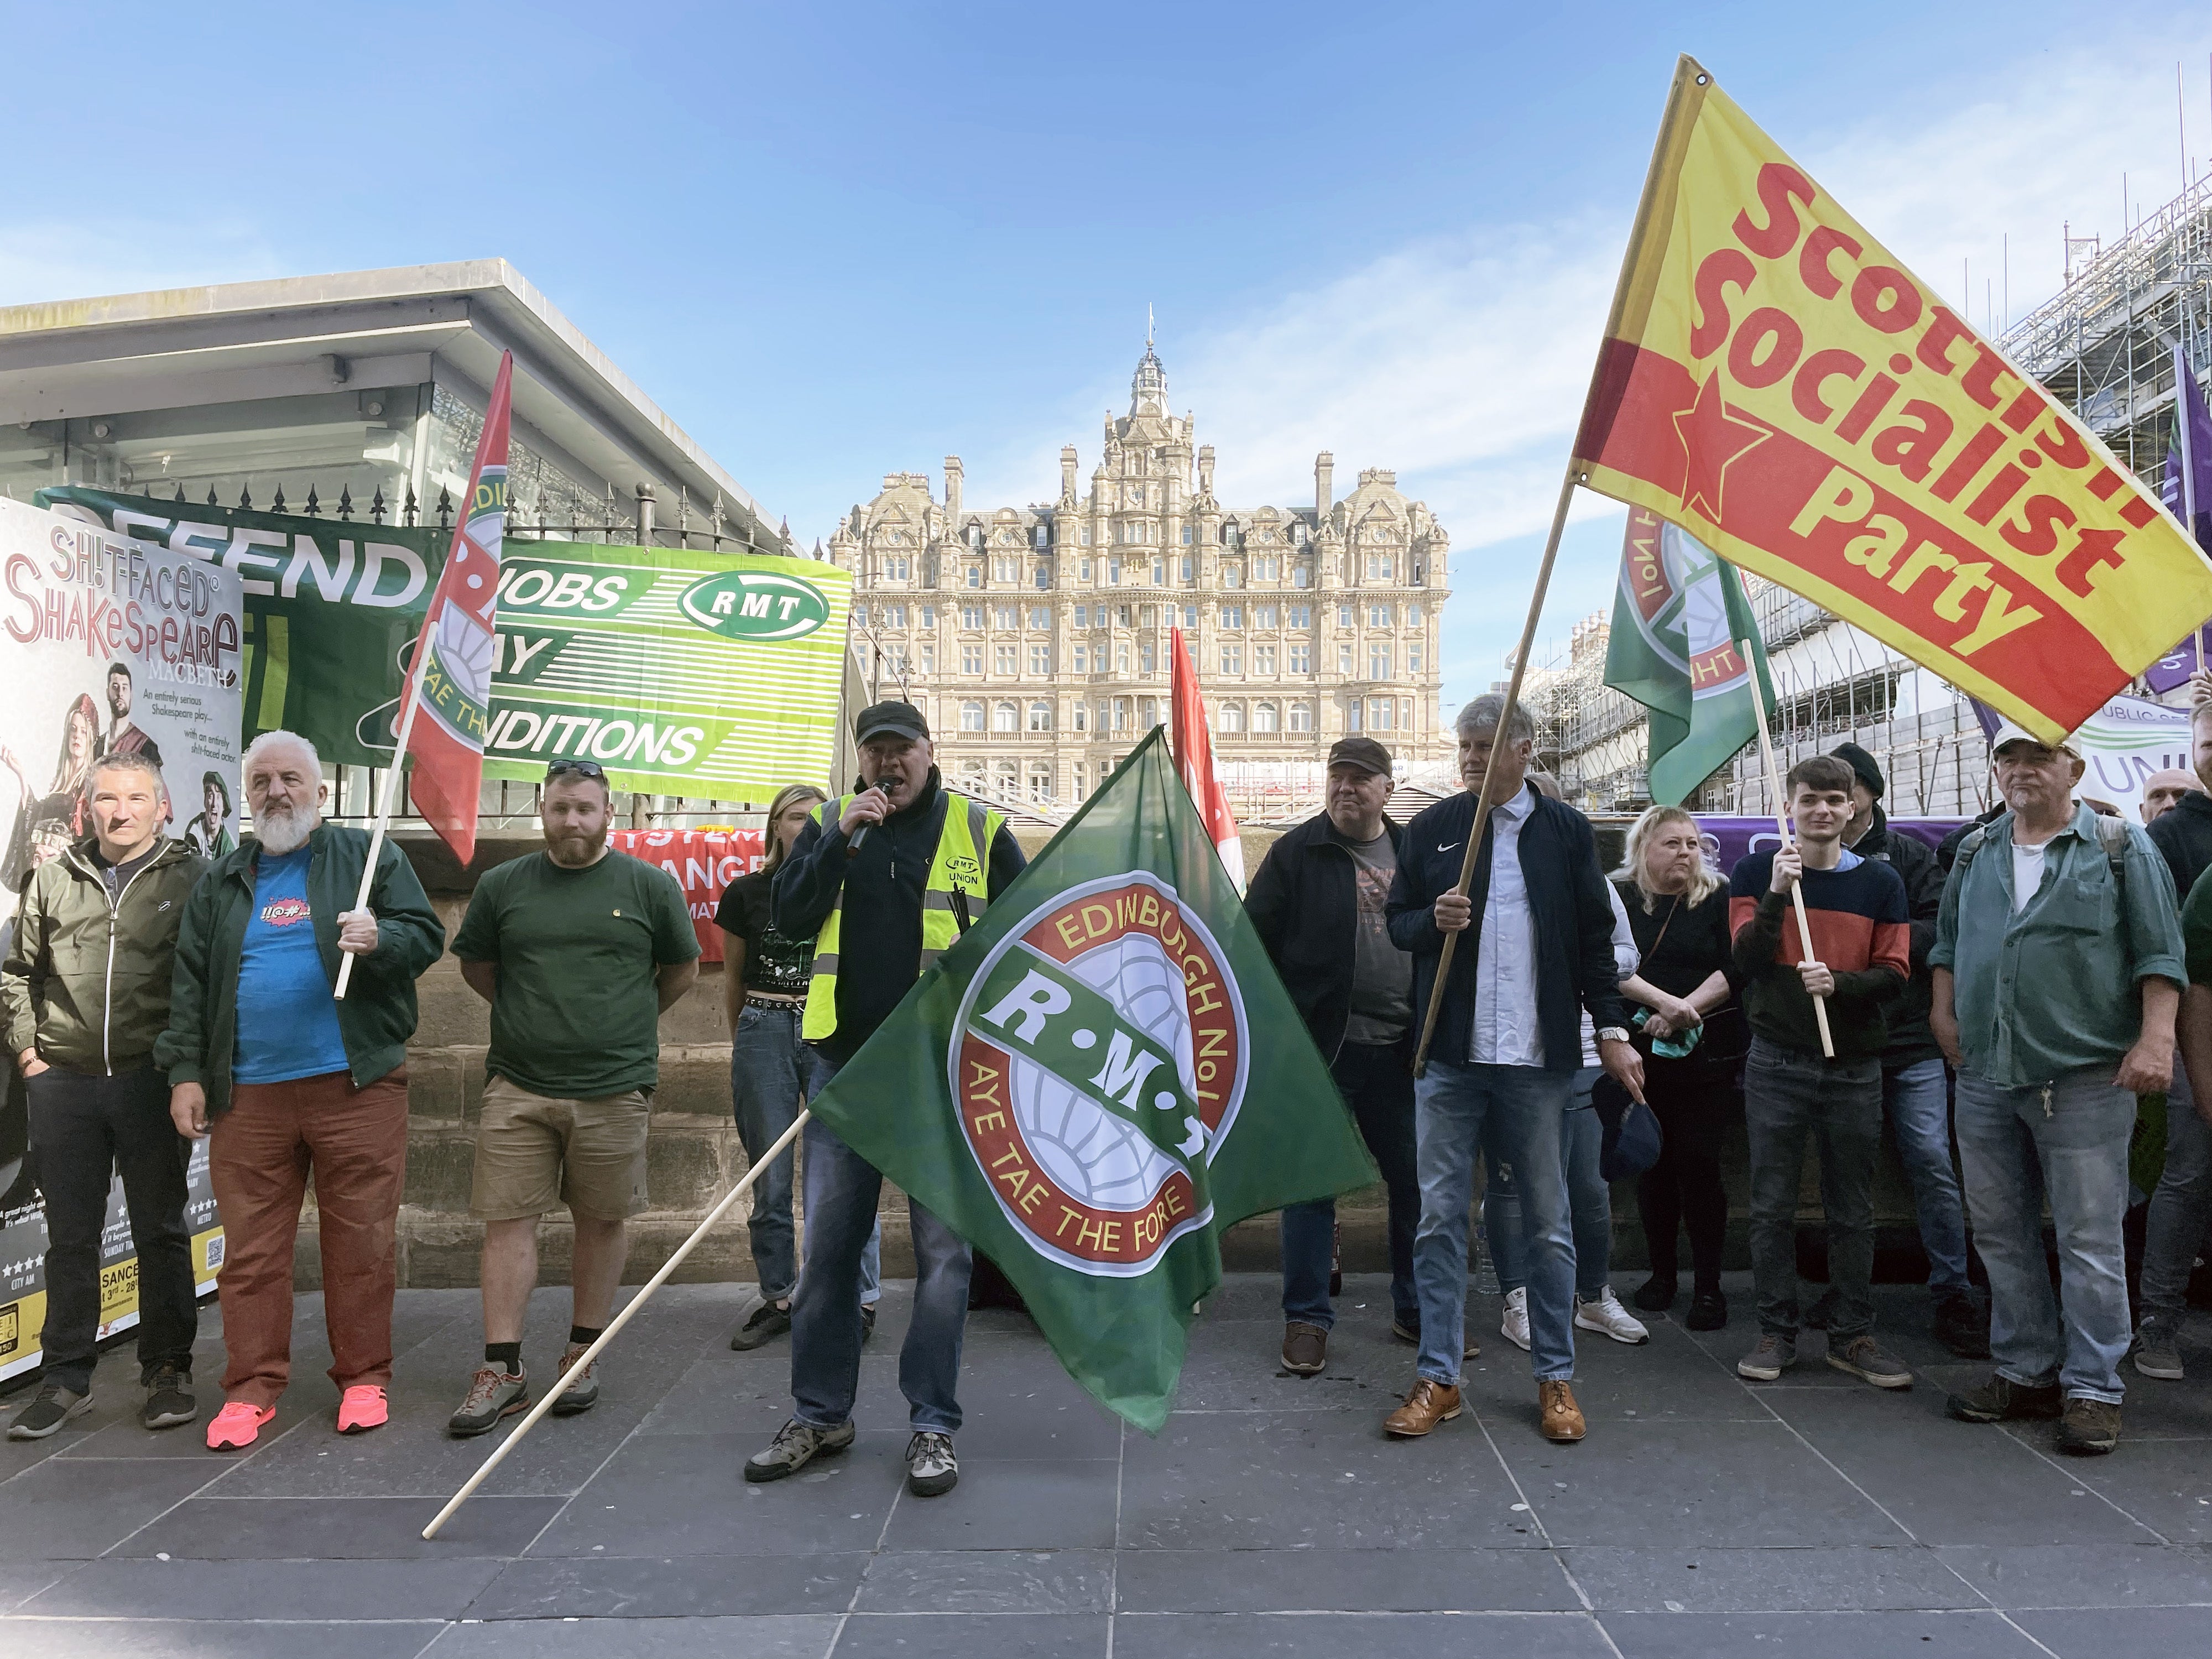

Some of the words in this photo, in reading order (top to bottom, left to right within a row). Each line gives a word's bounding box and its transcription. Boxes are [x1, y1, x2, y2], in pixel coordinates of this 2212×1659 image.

[1691, 249, 2131, 598] Socialist
[468, 483, 506, 515] DI
[1790, 465, 2043, 656] Party
[710, 591, 801, 620] RMT
[148, 659, 233, 689] MACBETH
[143, 688, 153, 700] An
[154, 691, 179, 706] entirely
[180, 694, 202, 706] serious
[152, 703, 192, 720] Shakespeare
[456, 699, 488, 738] TH
[184, 728, 197, 740] with
[199, 733, 207, 742] an
[208, 735, 229, 751] entirely
[953, 860, 974, 869] RMT
[949, 872, 978, 885] UNION
[968, 1060, 1006, 1135] AYE
[992, 1141, 1050, 1215] TAE
[1055, 1204, 1121, 1253] THE
[1135, 1186, 1186, 1252] FORE
[4, 1206, 20, 1219] great
[22, 1201, 36, 1213] night
[197, 1212, 212, 1225] METRO
[104, 1242, 125, 1259] SUNDAY
[11, 1276, 24, 1291] CITY
[25, 1273, 35, 1286] AM
[102, 1263, 139, 1288] SANCE
